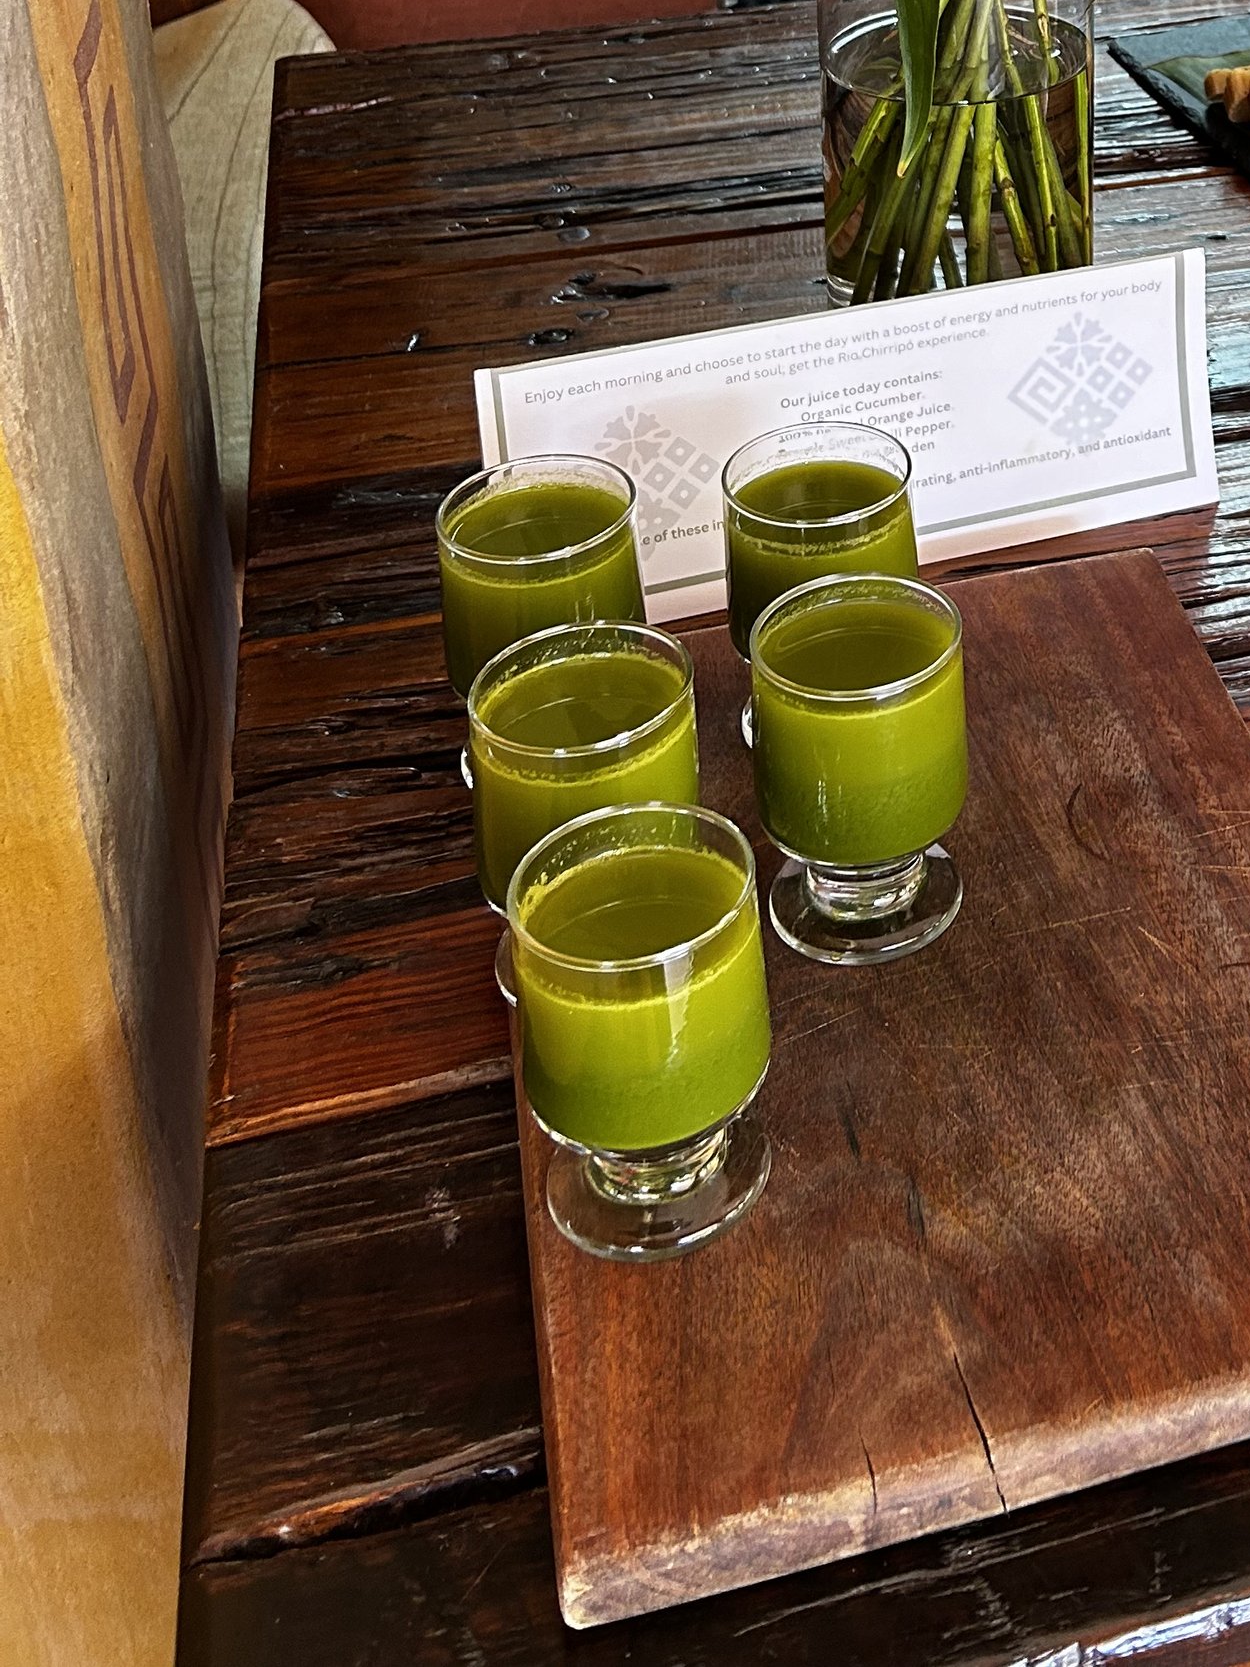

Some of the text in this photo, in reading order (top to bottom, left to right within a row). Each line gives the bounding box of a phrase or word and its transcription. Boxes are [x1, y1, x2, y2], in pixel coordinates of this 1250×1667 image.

[524, 279, 1162, 404] Enjoy each morning and choose to start the day with a boost of energy and nutrients for your body
[725, 370, 750, 385] and
[788, 360, 810, 376] get
[813, 355, 835, 369] the
[779, 370, 943, 410] Our juice today contains:
[800, 390, 926, 423] Organic Cucumber.
[867, 410, 914, 427] Orange
[916, 402, 955, 417] Juice.
[905, 420, 955, 437] Pepper.
[653, 529, 669, 543] of
[671, 523, 709, 540] these
[959, 447, 1076, 479] anti-inflammatory,
[1077, 440, 1101, 455] and
[1102, 426, 1172, 450] antioxidant
